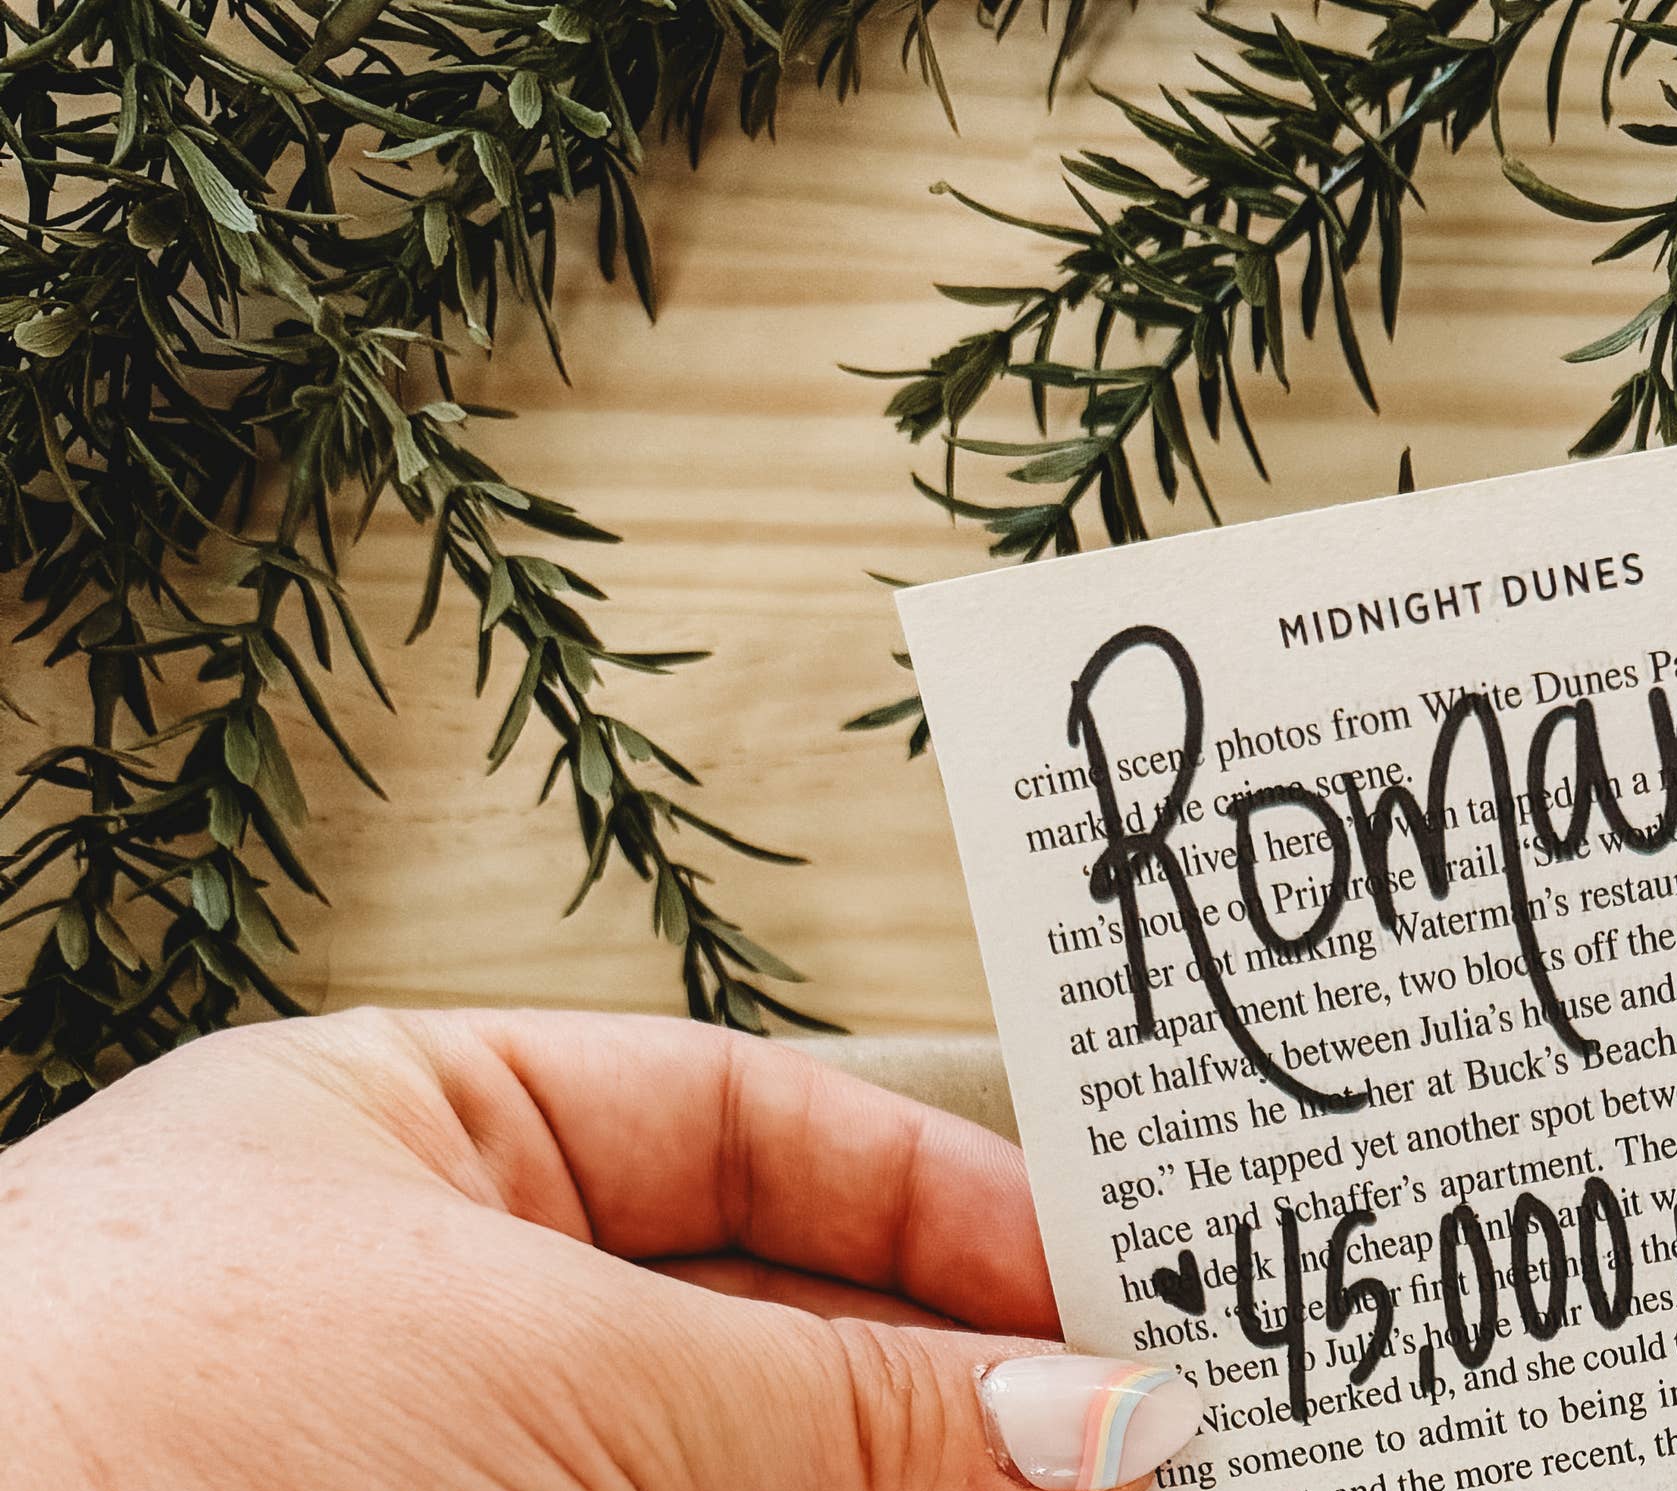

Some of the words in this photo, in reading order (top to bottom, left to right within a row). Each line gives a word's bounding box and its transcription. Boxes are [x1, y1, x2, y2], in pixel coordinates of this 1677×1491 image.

[1278, 580, 1487, 649] MIDNIGHT
[1501, 551, 1646, 608] DUNES
[1215, 722, 1323, 773] photos
[1331, 706, 1412, 743] from
[1532, 664, 1640, 706] Dunes
[1068, 1023, 1099, 1055] at
[1313, 978, 1392, 1012] here,
[1398, 966, 1458, 997] two
[1572, 928, 1622, 967] off
[1626, 921, 1677, 957] the
[1078, 1068, 1145, 1111] spot
[1280, 1026, 1411, 1070] between
[1619, 971, 1677, 1011] and
[1087, 1123, 1128, 1156] he
[1136, 1108, 1239, 1148] claims
[1246, 1095, 1288, 1128] he
[1425, 1066, 1455, 1097] at
[1184, 1157, 1233, 1190] He
[1238, 1134, 1343, 1184] tapped
[1350, 1128, 1398, 1170] yet
[1404, 1108, 1523, 1152] another
[1529, 1094, 1595, 1137] spot
[1109, 1219, 1194, 1262] place
[1204, 1199, 1262, 1238] and
[1438, 1144, 1604, 1202] apartment.
[1345, 1229, 1436, 1264] cheap
[1132, 1315, 1218, 1351] shots.
[1234, 1176, 1636, 1423] 45,000
[1462, 1354, 1517, 1391] and
[1524, 1347, 1576, 1381] she
[1581, 1329, 1667, 1371] could
[1153, 1457, 1218, 1490] ting
[1226, 1435, 1366, 1477] someone
[1373, 1426, 1407, 1453] to
[1417, 1405, 1508, 1446] admit
[1516, 1403, 1549, 1430] to
[1558, 1387, 1648, 1423] being
[1454, 1457, 1534, 1489] more
[1540, 1435, 1647, 1476] recent,
